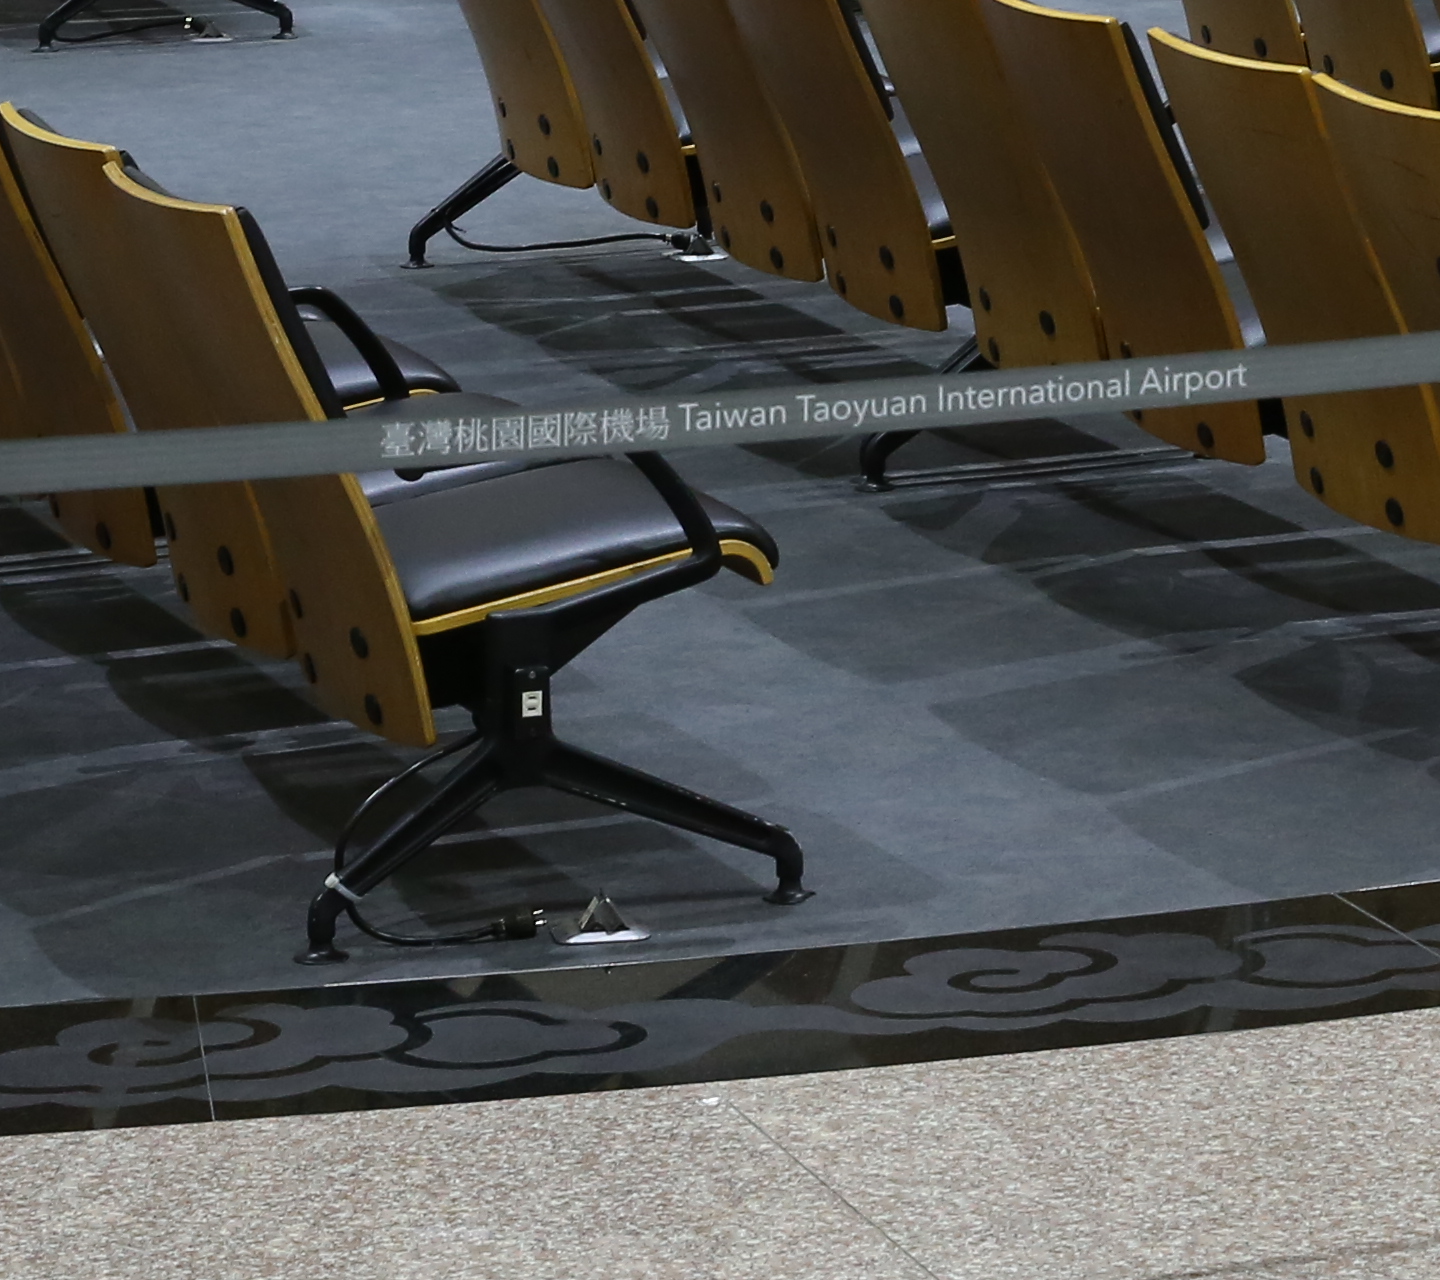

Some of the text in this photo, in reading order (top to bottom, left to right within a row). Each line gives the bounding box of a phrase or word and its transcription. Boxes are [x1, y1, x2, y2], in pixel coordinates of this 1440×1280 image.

[379, 361, 1248, 461] 臺灣桃園國際機場 Taiwan Taoyuan International Airport
